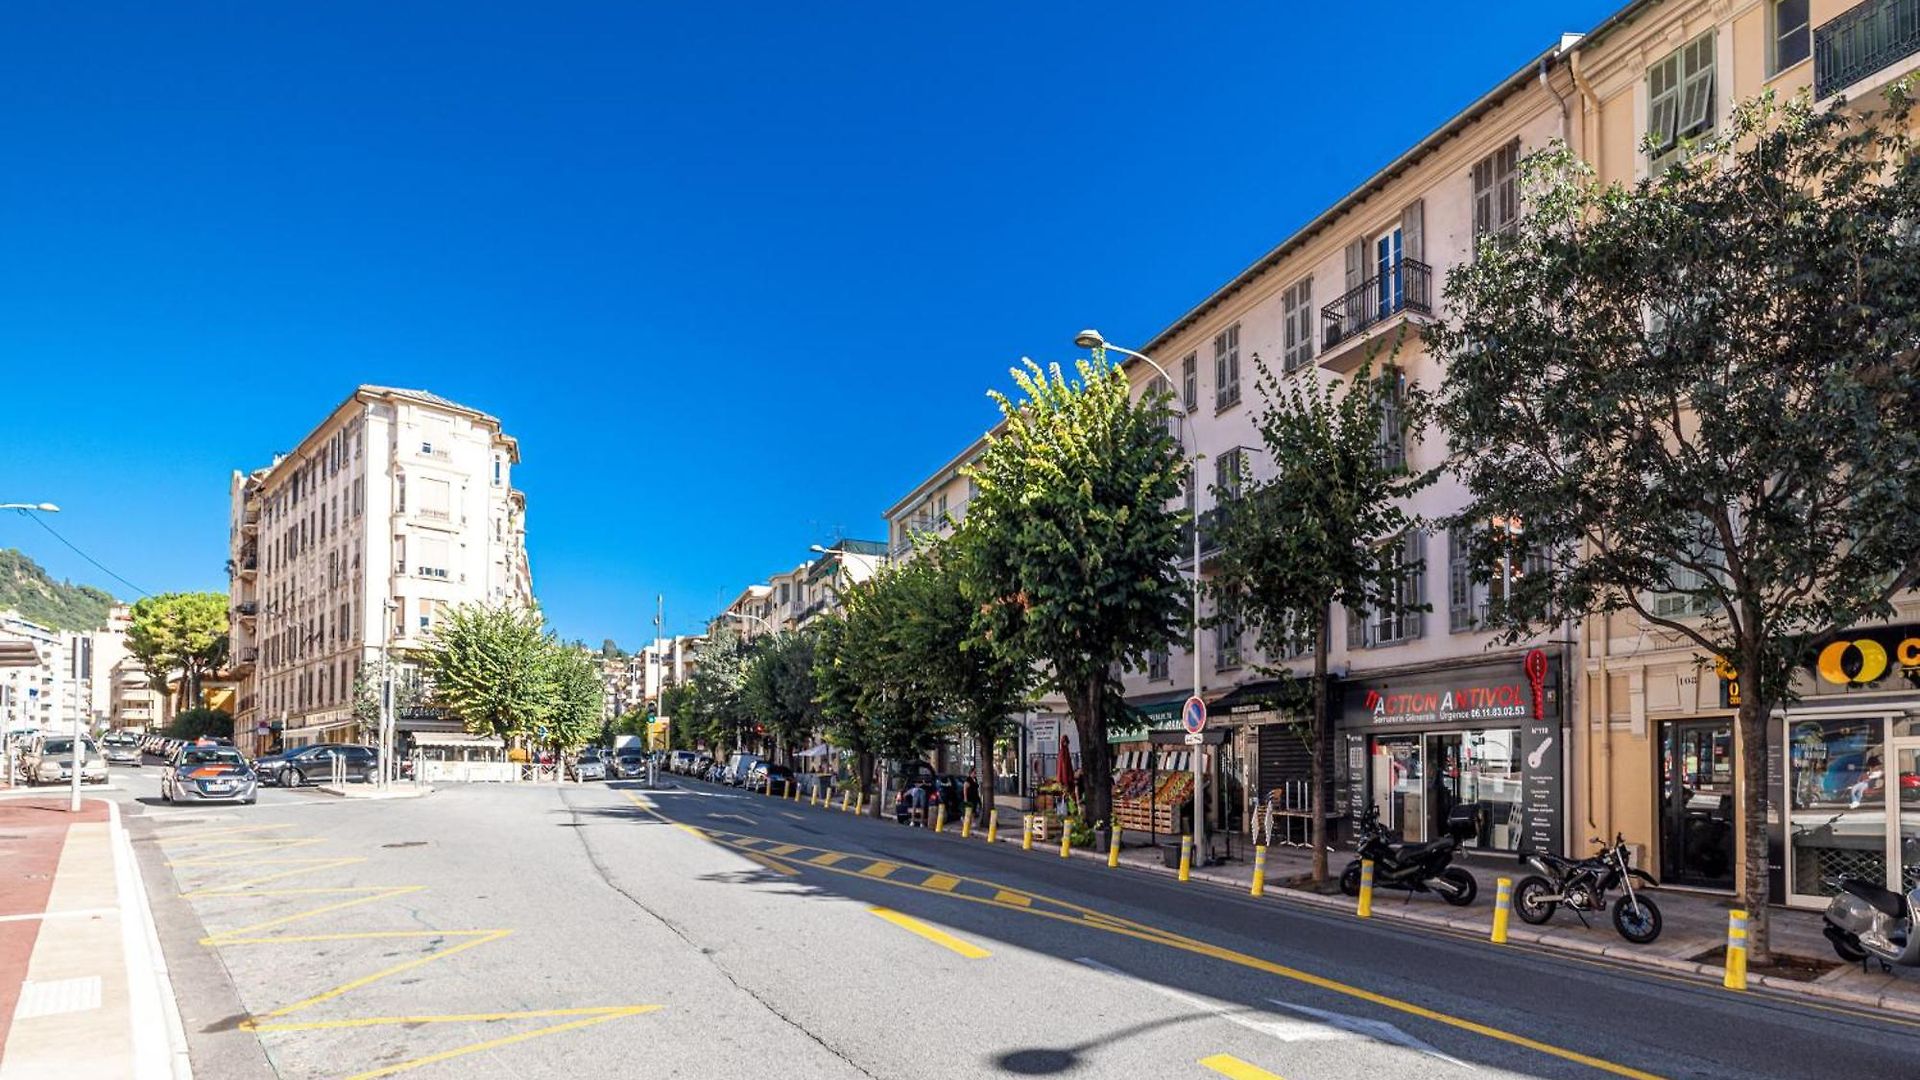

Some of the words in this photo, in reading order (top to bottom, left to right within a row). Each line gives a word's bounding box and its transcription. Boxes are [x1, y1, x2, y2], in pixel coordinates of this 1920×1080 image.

[1373, 692, 1438, 715] ACTION
[1440, 683, 1526, 711] ANTIVOL
[1440, 711, 1469, 721] Urgence
